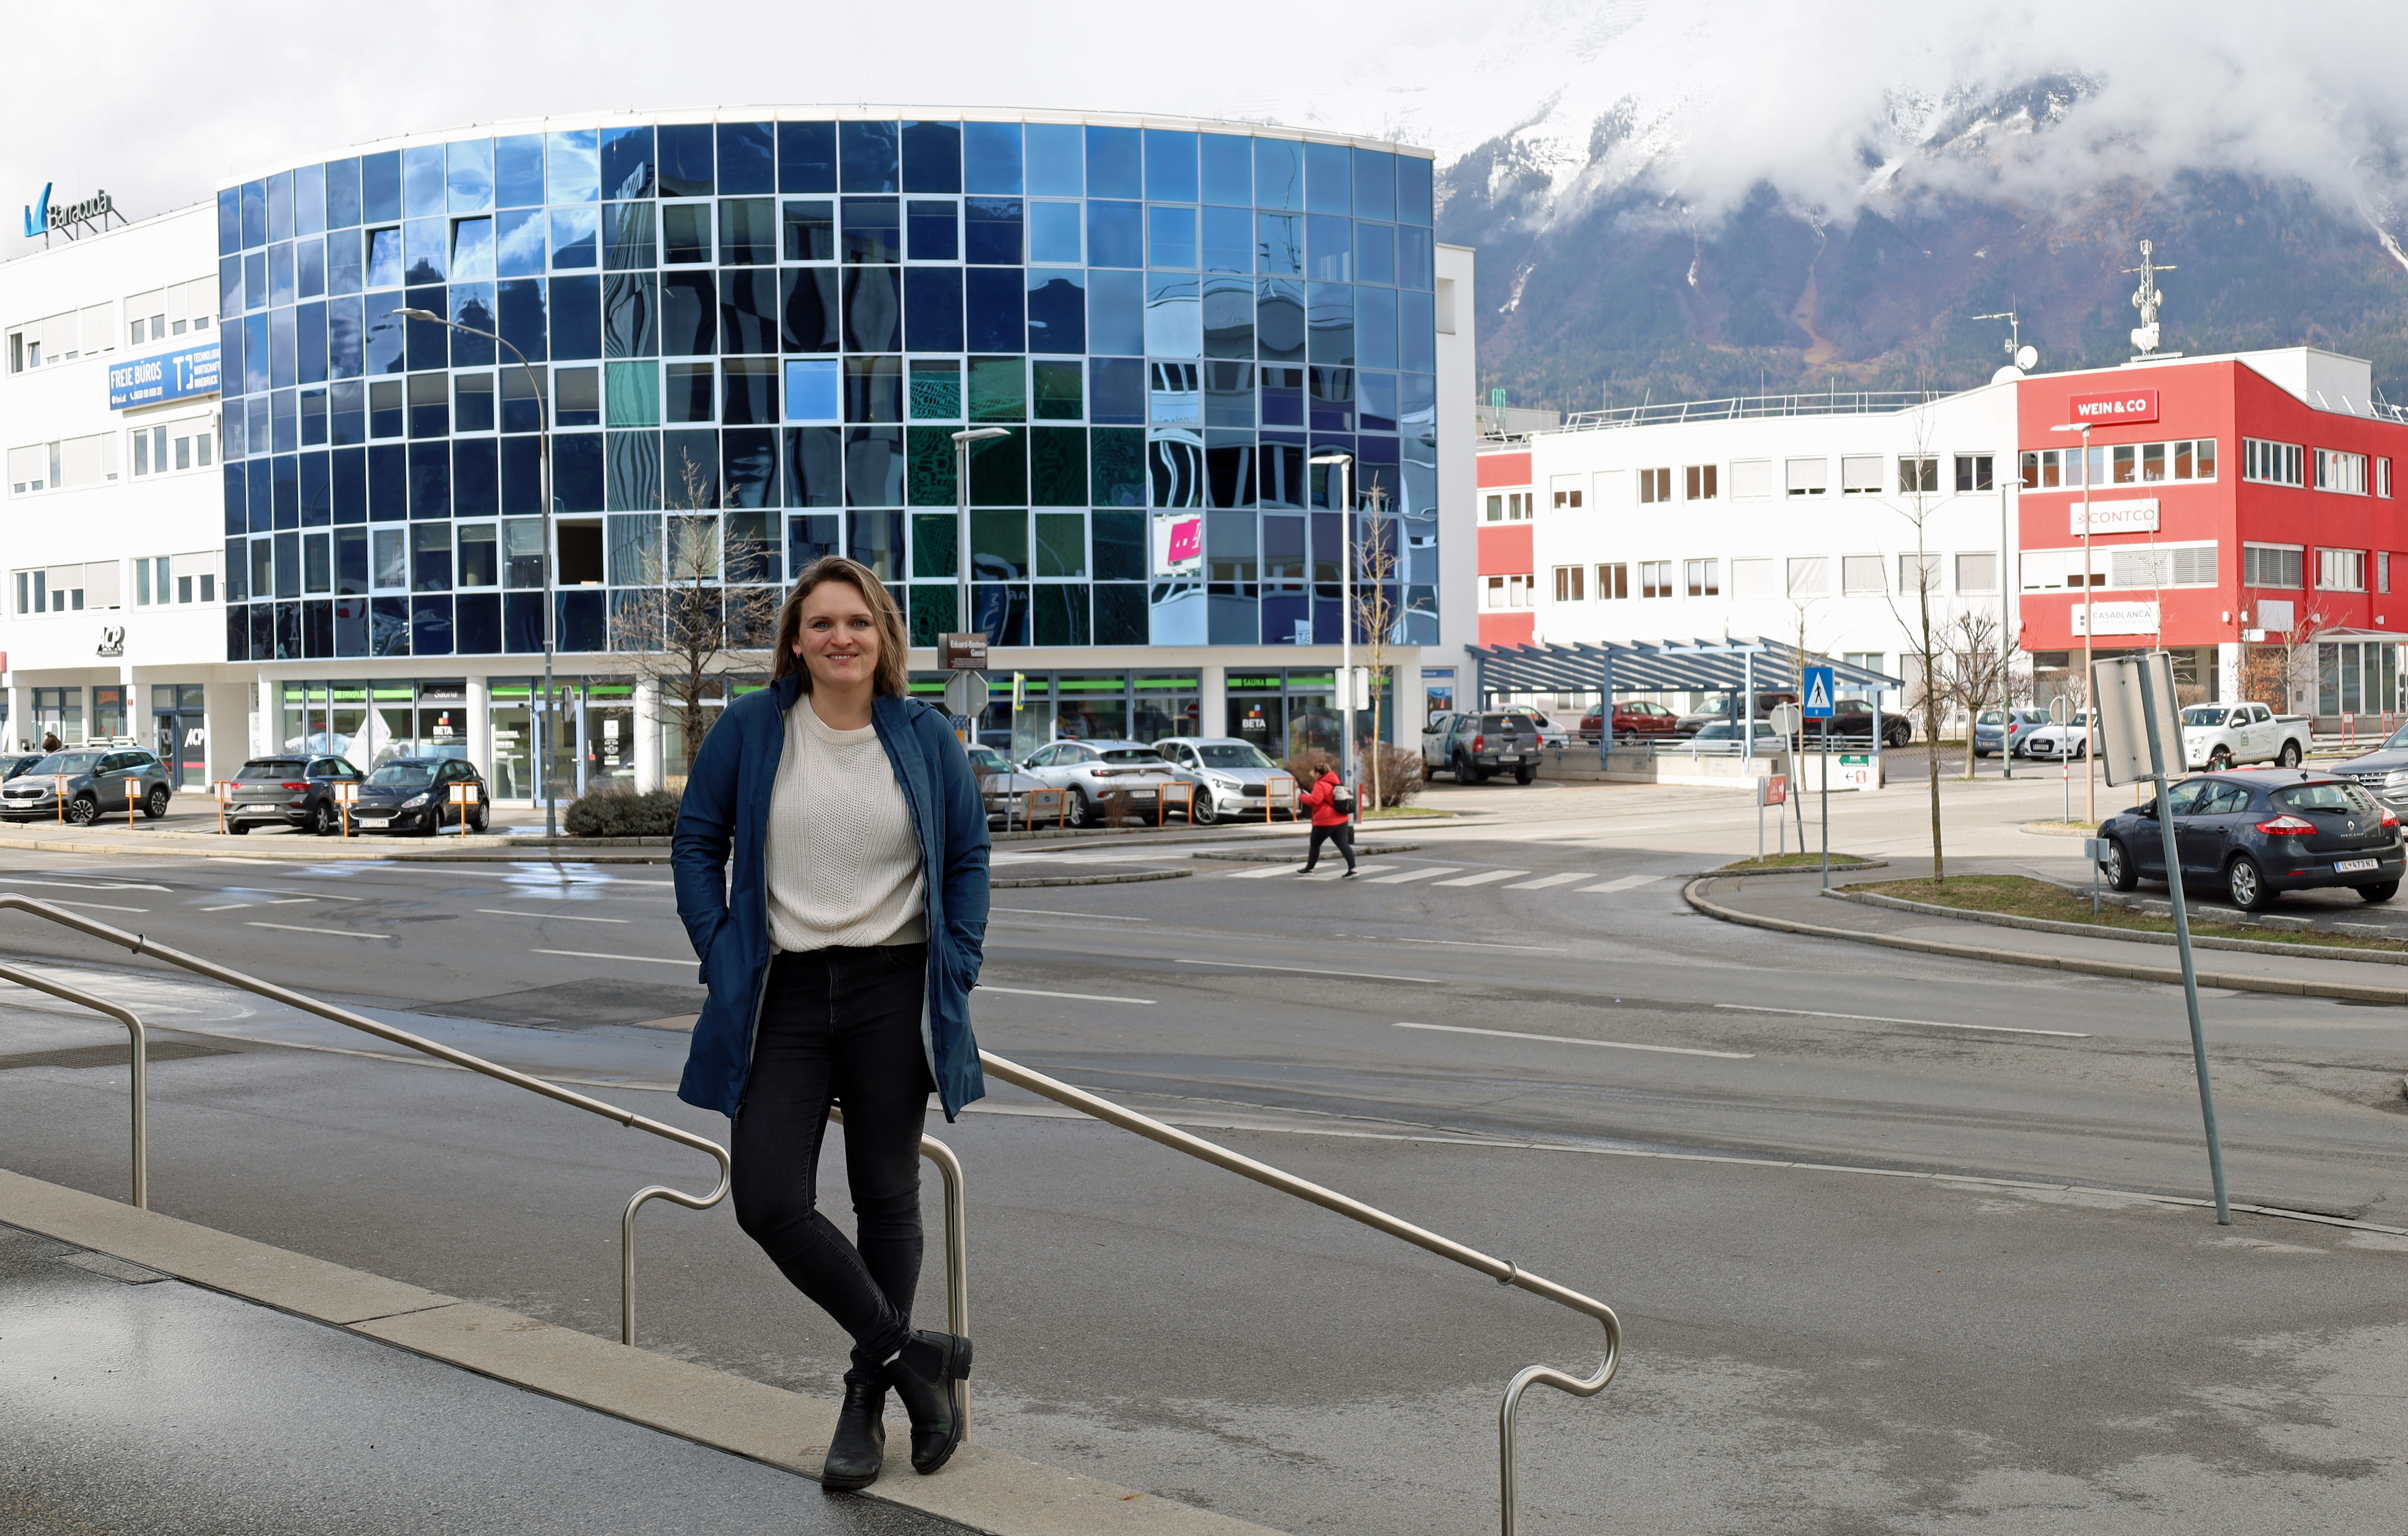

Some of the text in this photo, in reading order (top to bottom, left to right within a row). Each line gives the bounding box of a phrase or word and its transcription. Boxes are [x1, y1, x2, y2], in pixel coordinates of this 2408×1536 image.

[48, 194, 106, 229] Barracuda
[111, 361, 162, 389] FREIE BÜROS
[194, 375, 218, 388] INNSBRUCK
[2078, 399, 2146, 416] WEIN & CO
[2089, 509, 2155, 523] CONTCO
[2093, 610, 2150, 619] CASABLANCA
[971, 648, 986, 657] Gasse
[1243, 678, 1266, 687] SAUNA
[434, 690, 458, 698] Sauna
[1242, 718, 1266, 728] BETA
[433, 726, 454, 735] BETA
[184, 728, 204, 747] ACP
